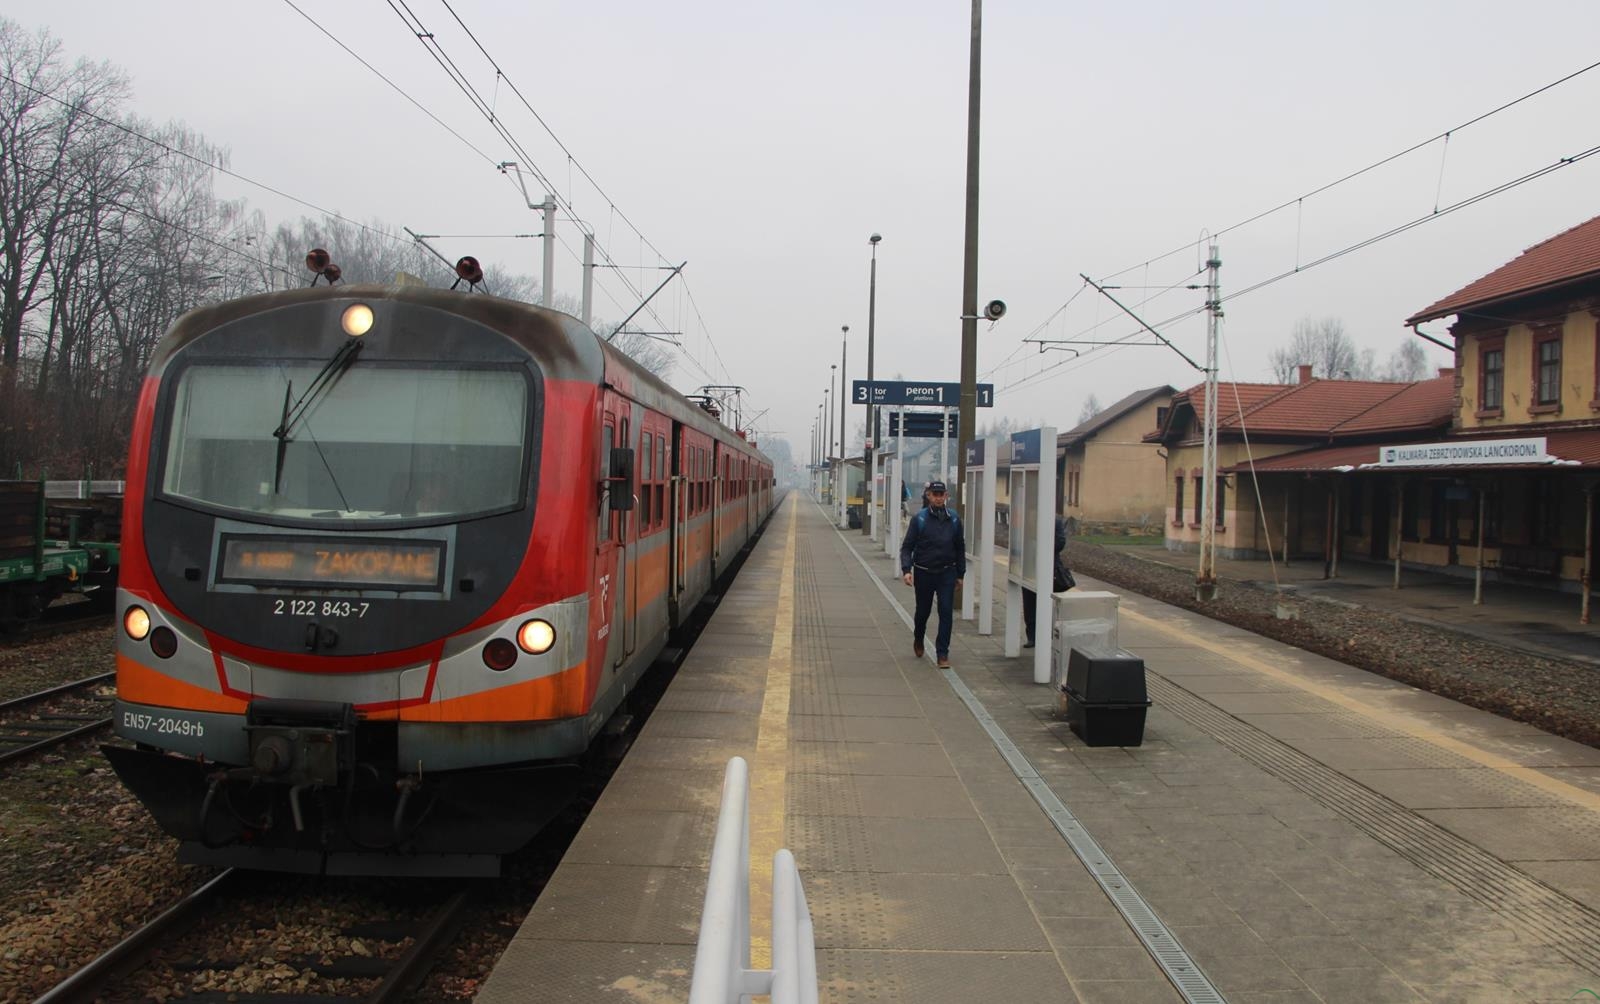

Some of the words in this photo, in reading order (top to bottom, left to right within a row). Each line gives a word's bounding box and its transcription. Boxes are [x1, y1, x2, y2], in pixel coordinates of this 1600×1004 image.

[858, 387, 868, 400] 3
[874, 387, 887, 395] tor
[906, 387, 934, 396] peron
[936, 387, 944, 402] 1
[982, 390, 989, 403] 1
[1484, 445, 1537, 458] LANCKORONA
[314, 550, 434, 578] ZAKOPANE
[274, 600, 284, 614] 2
[291, 600, 315, 616] 122
[322, 601, 369, 618] 843-7
[124, 712, 204, 736] EN57-2049rb
